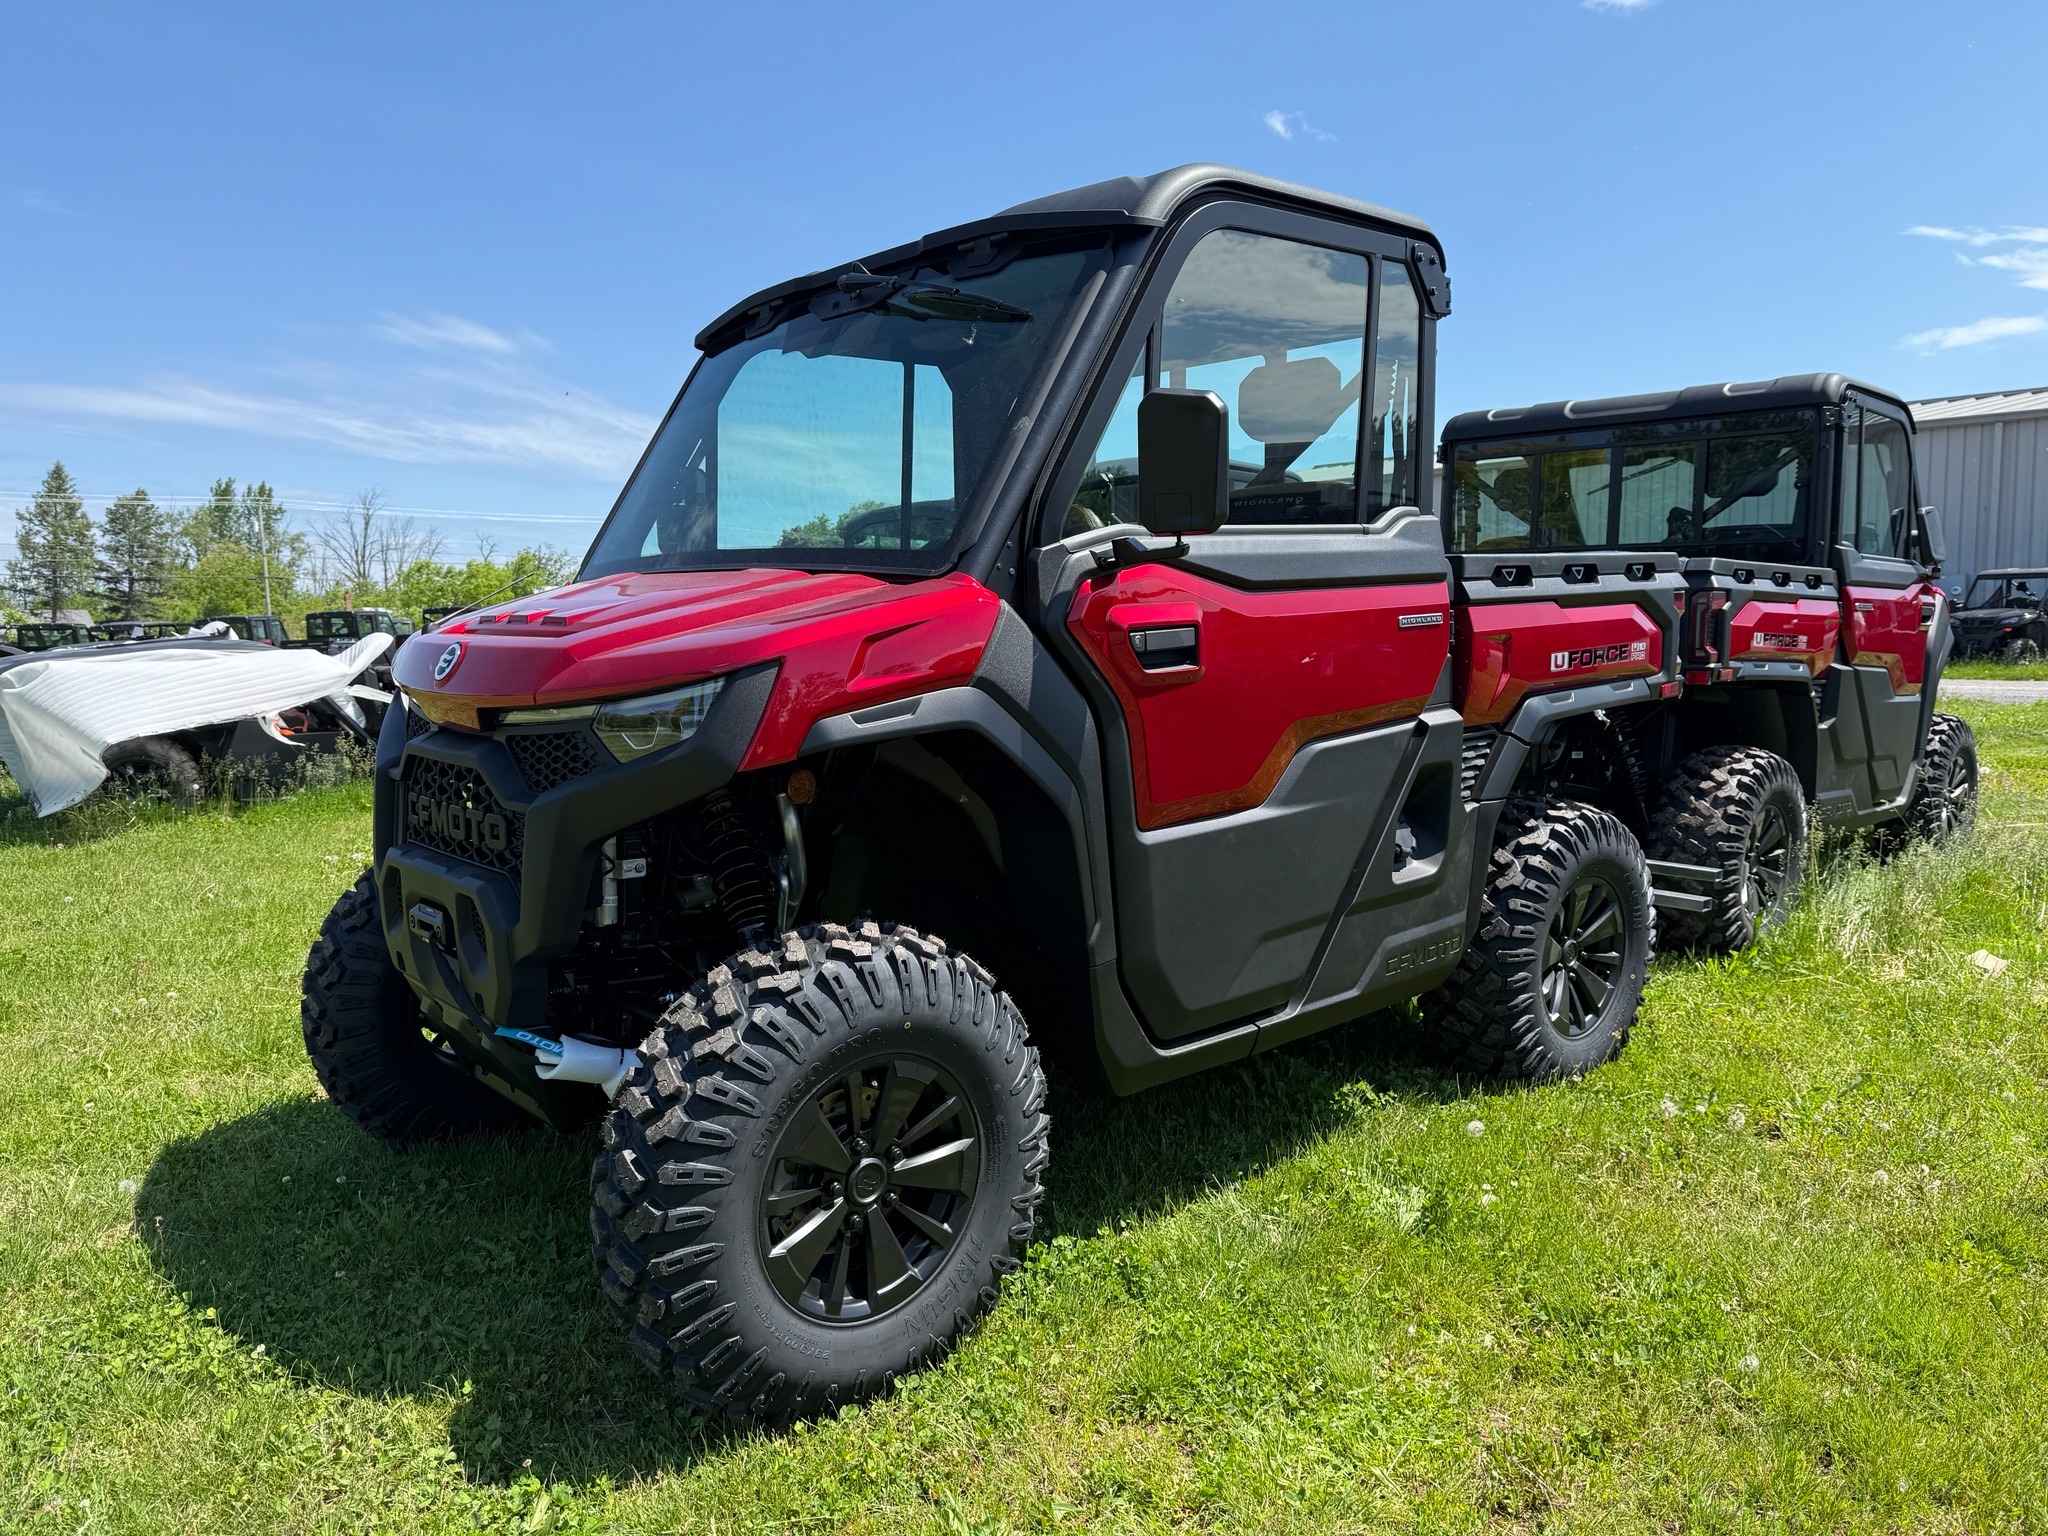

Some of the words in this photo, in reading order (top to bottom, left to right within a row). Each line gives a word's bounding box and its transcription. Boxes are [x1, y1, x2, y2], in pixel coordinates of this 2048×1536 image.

[1234, 496, 1304, 508] HIGHLAND
[1402, 616, 1442, 625] HIGHLAND
[407, 791, 508, 851] CFMOTO
[1385, 934, 1462, 977] CFMOTO
